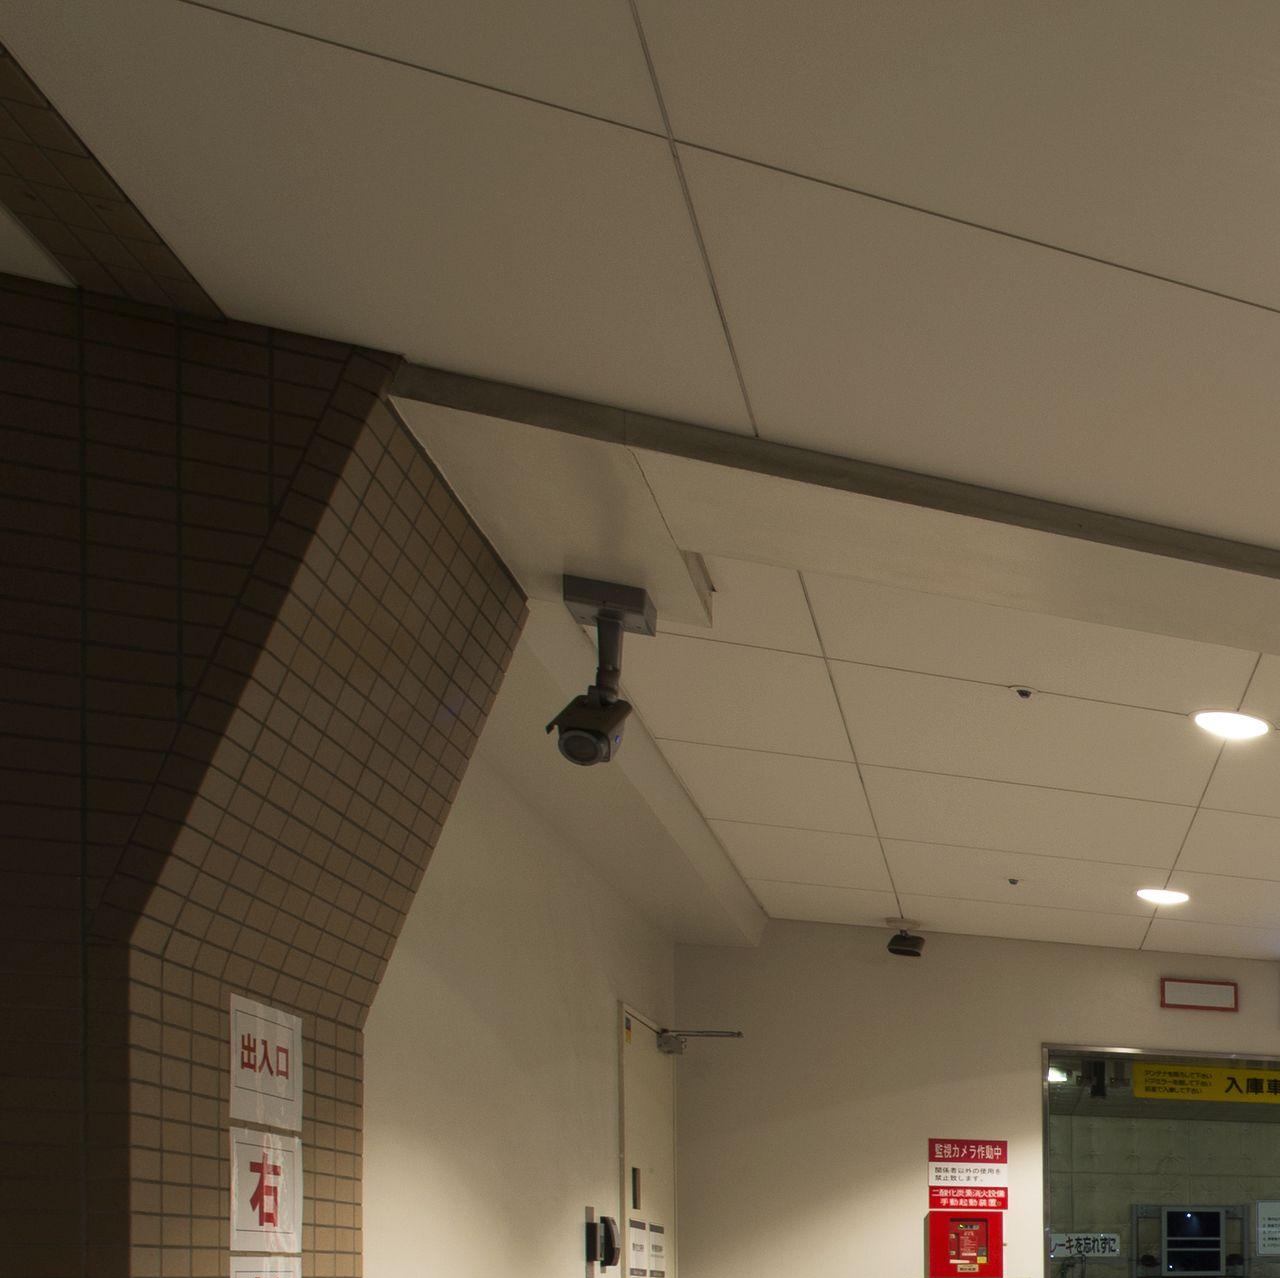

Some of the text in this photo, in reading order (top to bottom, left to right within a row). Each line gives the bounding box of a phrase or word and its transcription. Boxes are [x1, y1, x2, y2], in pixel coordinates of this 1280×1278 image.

[240, 1033, 289, 1080] 出入口
[934, 1143, 1002, 1160] 監視カメラ作動中
